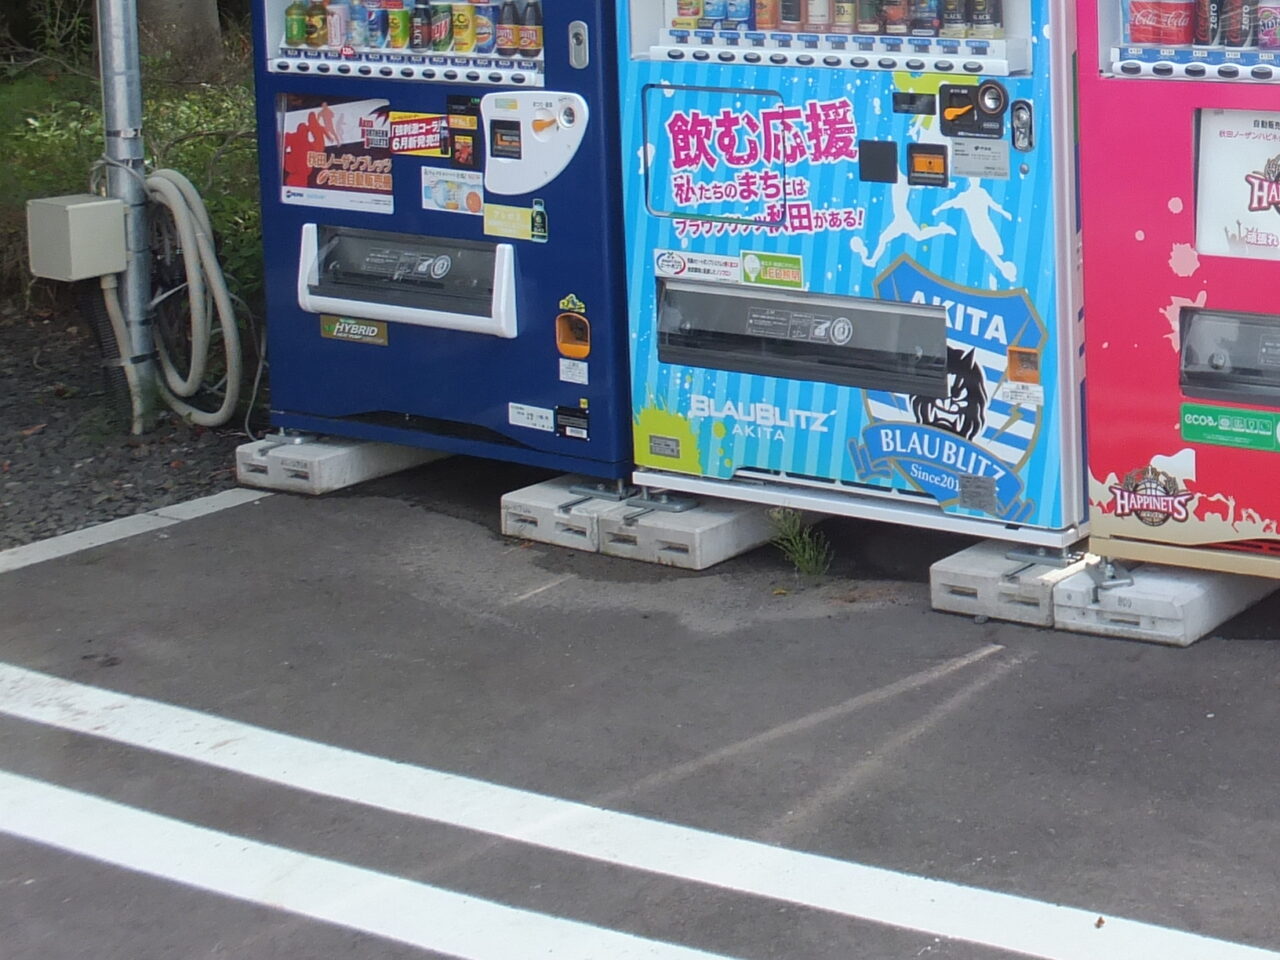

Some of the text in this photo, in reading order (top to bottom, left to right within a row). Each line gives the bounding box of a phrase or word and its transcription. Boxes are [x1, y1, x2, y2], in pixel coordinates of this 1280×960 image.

[1209, 3, 1218, 30] zero
[1241, 4, 1250, 31] zero
[667, 99, 858, 169] 飲む応援
[333, 322, 378, 337] HYBRID
[687, 394, 838, 433] BLAUBLITZ
[731, 423, 785, 442] AKITA
[1109, 486, 1194, 522] HAPPINETS
